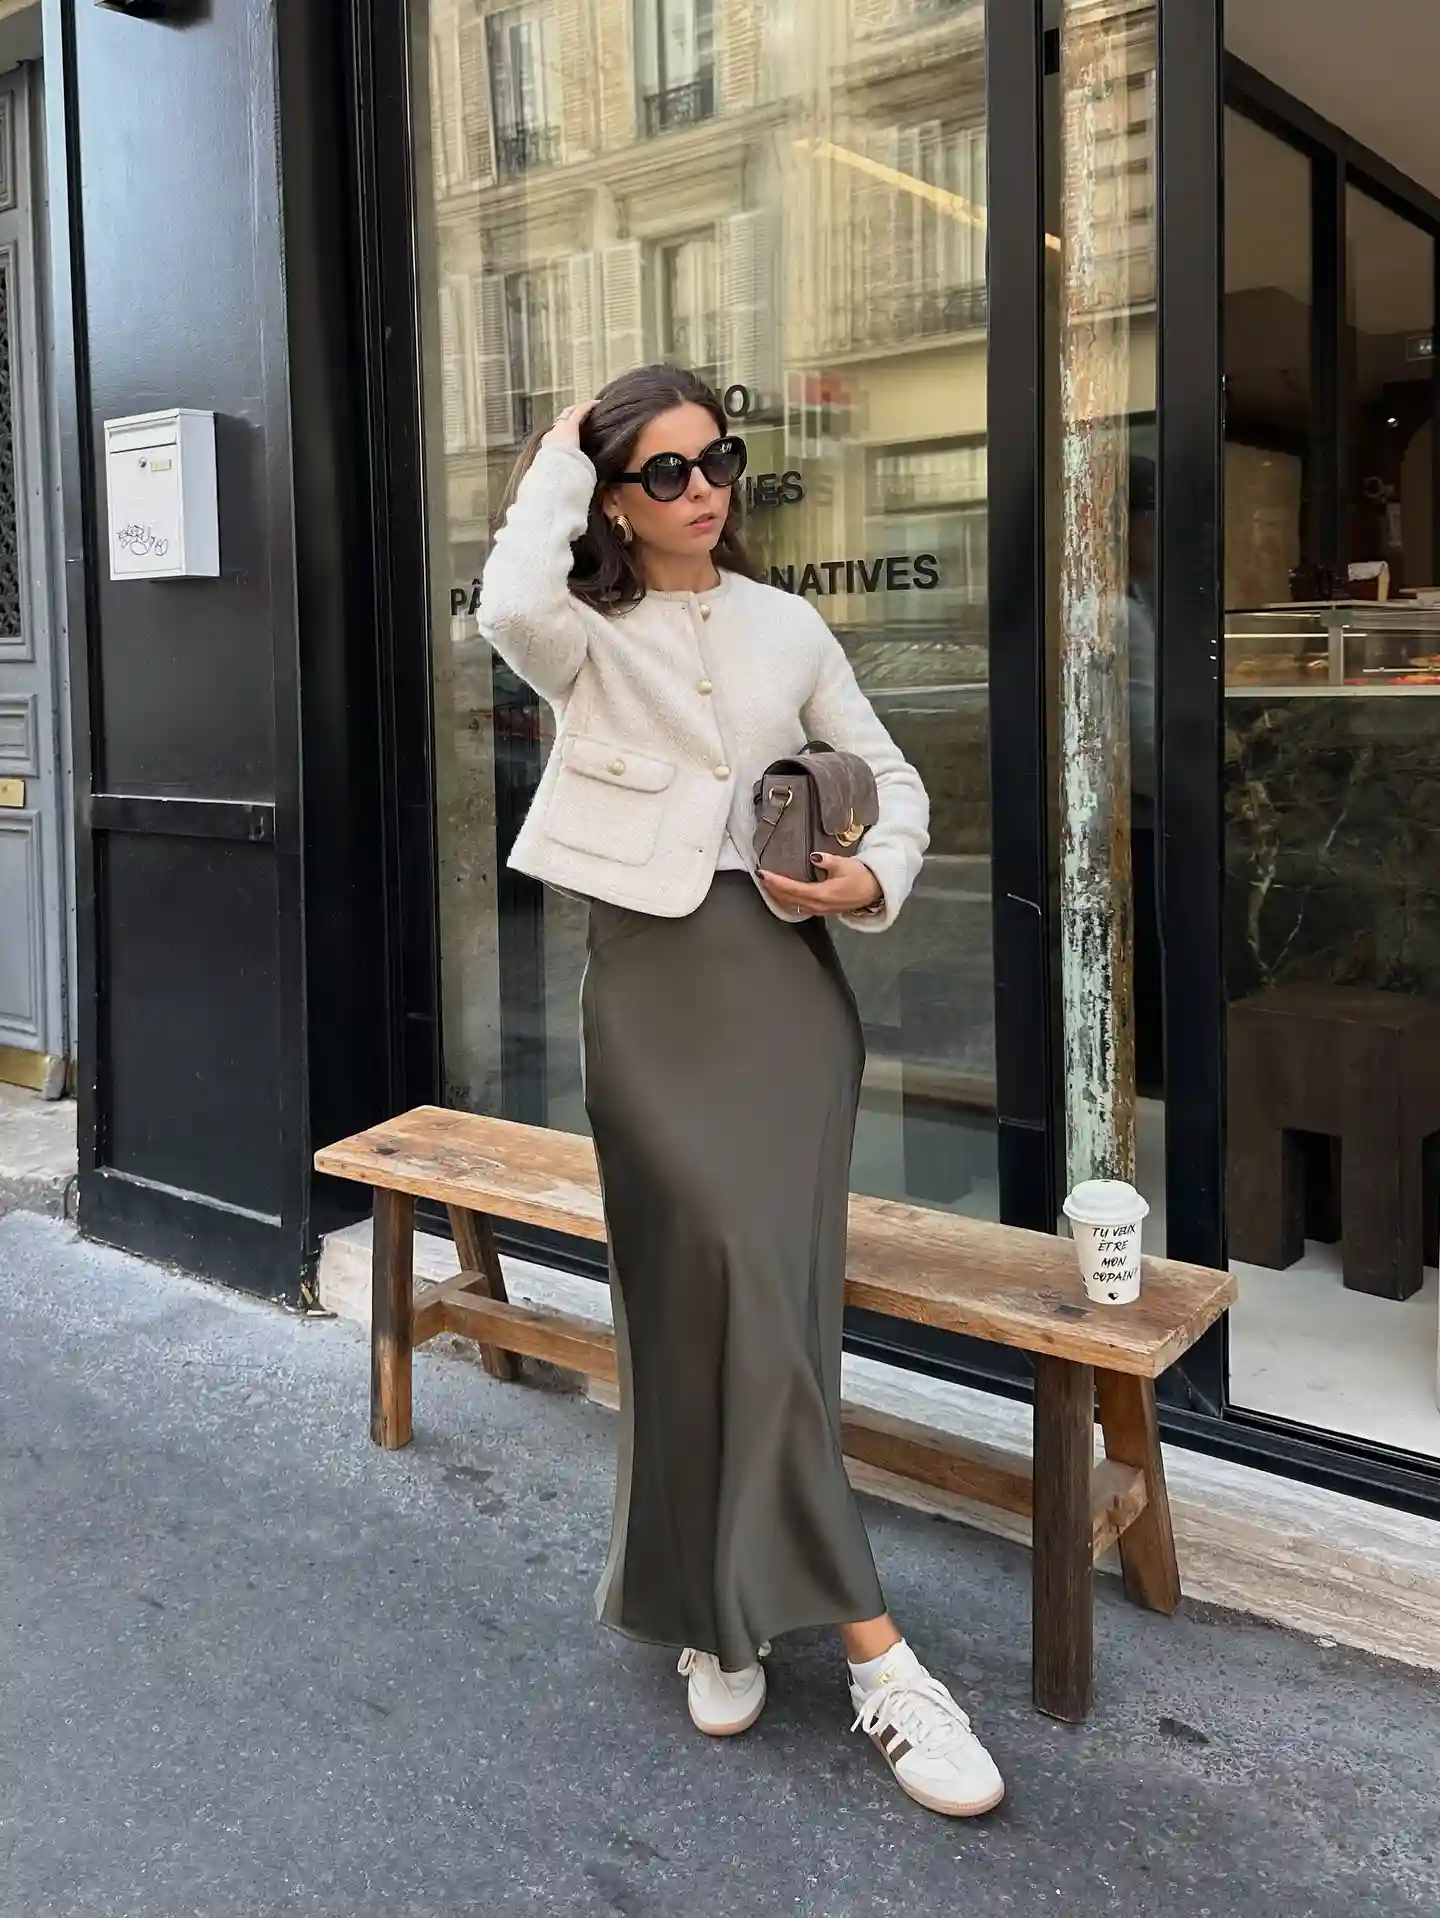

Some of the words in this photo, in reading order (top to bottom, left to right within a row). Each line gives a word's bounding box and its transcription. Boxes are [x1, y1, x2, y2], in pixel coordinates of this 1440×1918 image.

[770, 553, 940, 596] NATIVES
[1093, 1227, 1109, 1238] TU
[1113, 1224, 1136, 1237] VEUX
[1098, 1239, 1128, 1252] ÊTRE
[1100, 1256, 1128, 1268] MON
